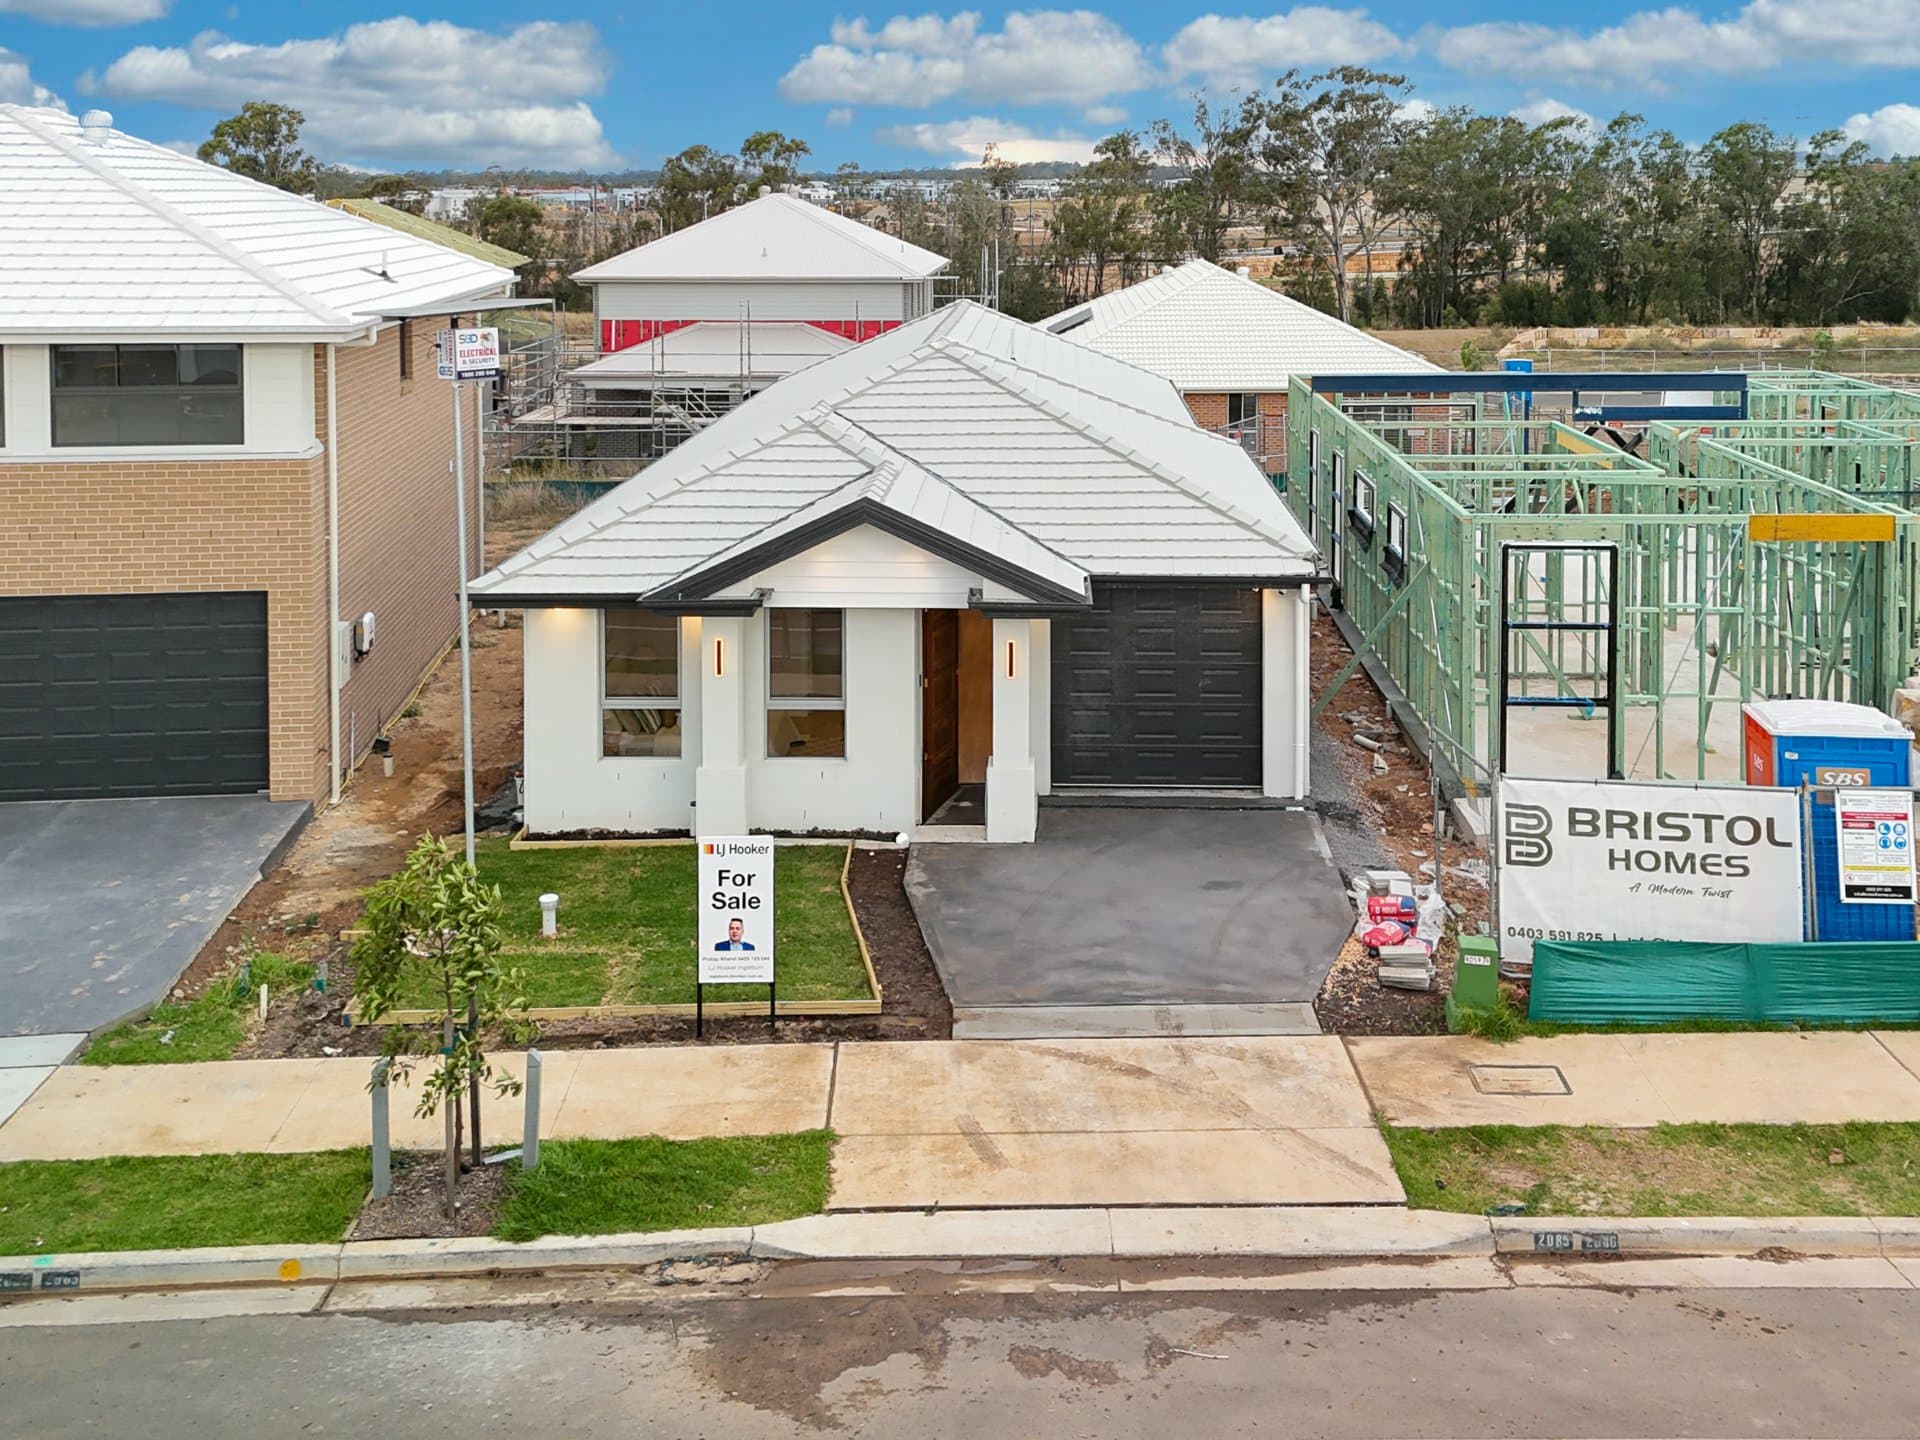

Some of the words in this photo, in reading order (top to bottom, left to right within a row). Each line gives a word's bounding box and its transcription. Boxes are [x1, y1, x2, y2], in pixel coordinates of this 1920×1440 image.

[460, 348, 497, 358] ELECTRICAL
[1821, 771, 1866, 786] SBS
[1568, 807, 1793, 848] BRISTOL
[716, 843, 726, 857] LJ
[729, 843, 770, 855] Hooker
[1608, 848, 1751, 877] HOMES
[718, 869, 757, 887] For
[1628, 882, 1642, 893] A
[1648, 883, 1695, 896] Modern
[1702, 887, 1734, 899] Twist
[711, 891, 761, 910] Sale
[1507, 926, 1544, 940] 0403
[1549, 930, 1572, 942] 591
[1577, 932, 1603, 942] 825
[1538, 1233, 1571, 1247] 2085
